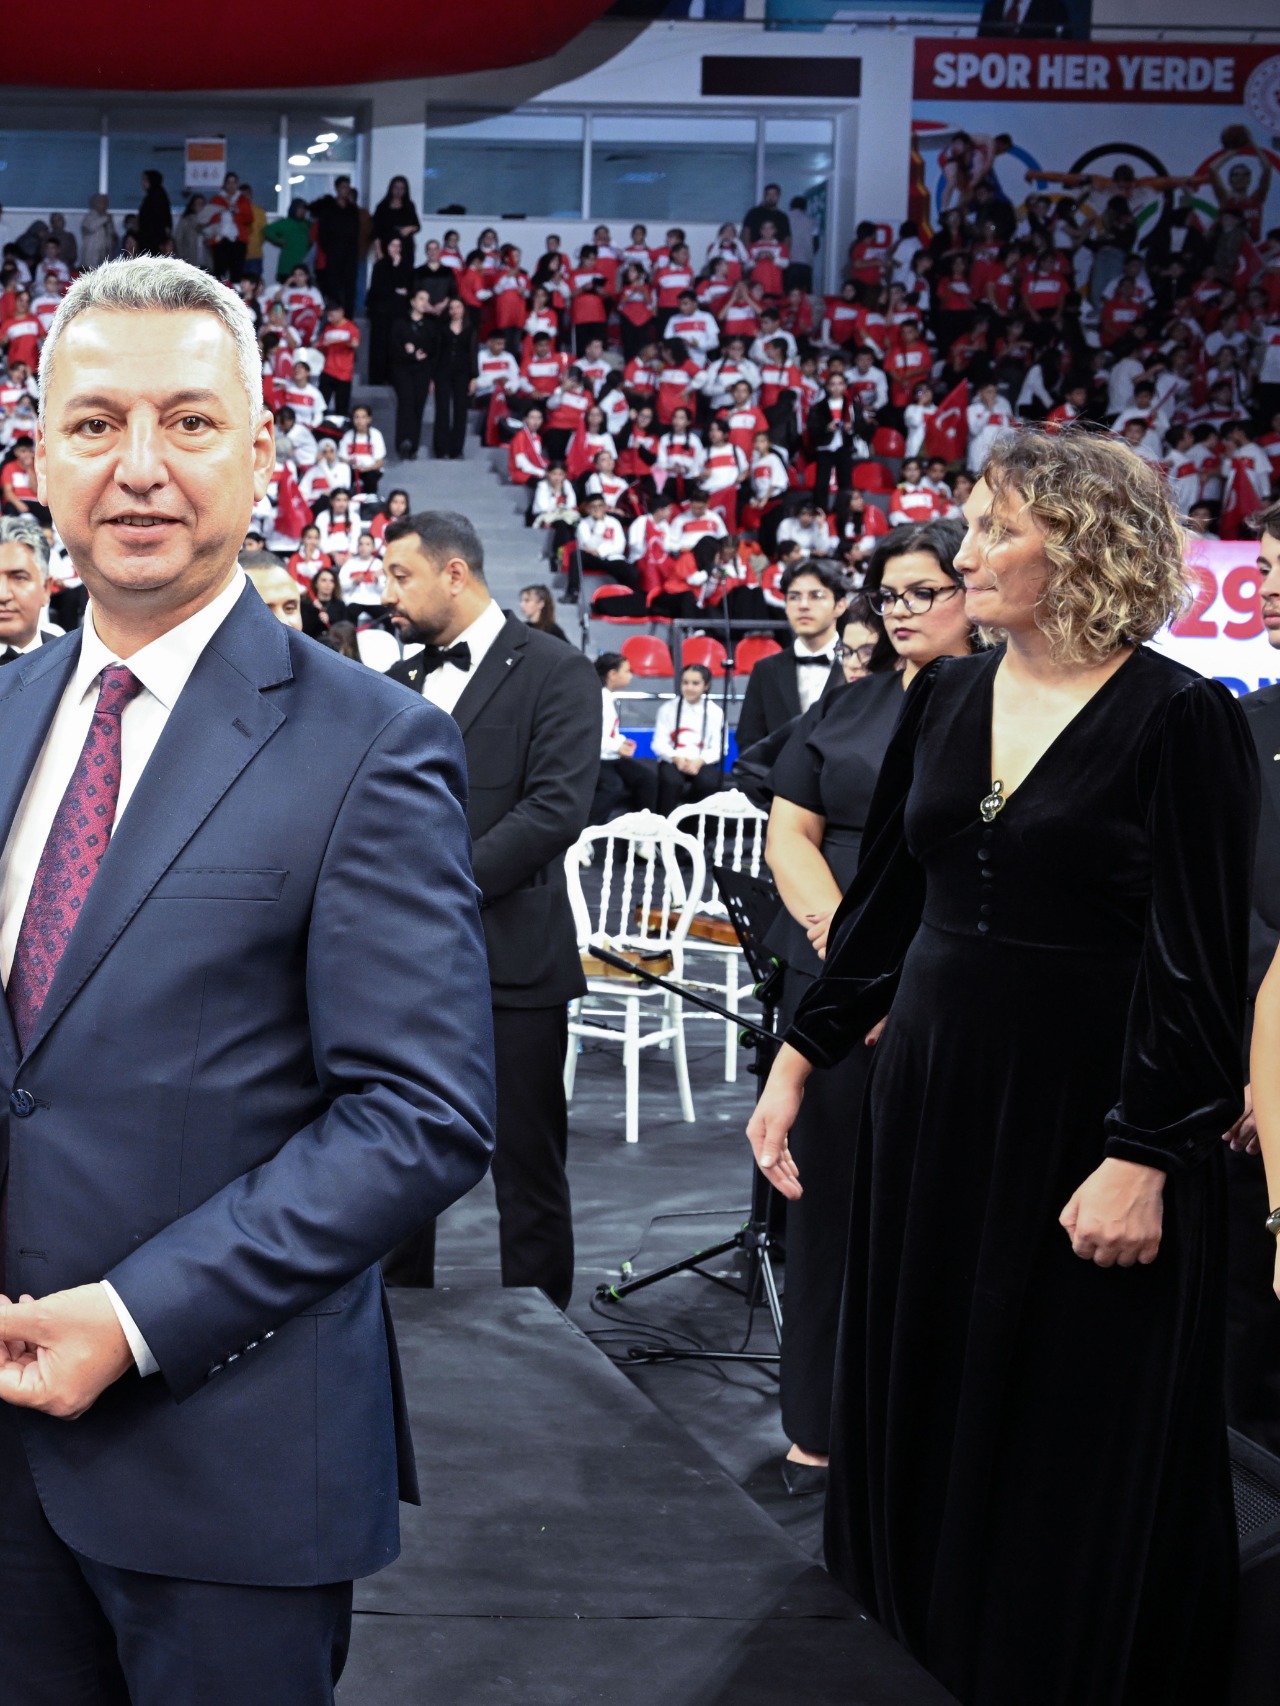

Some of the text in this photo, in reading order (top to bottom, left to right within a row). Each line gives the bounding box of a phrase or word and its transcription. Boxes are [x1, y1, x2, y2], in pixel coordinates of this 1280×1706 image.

[932, 52, 1235, 92] SPOR HER YERDE
[1170, 565, 1265, 641] 29
